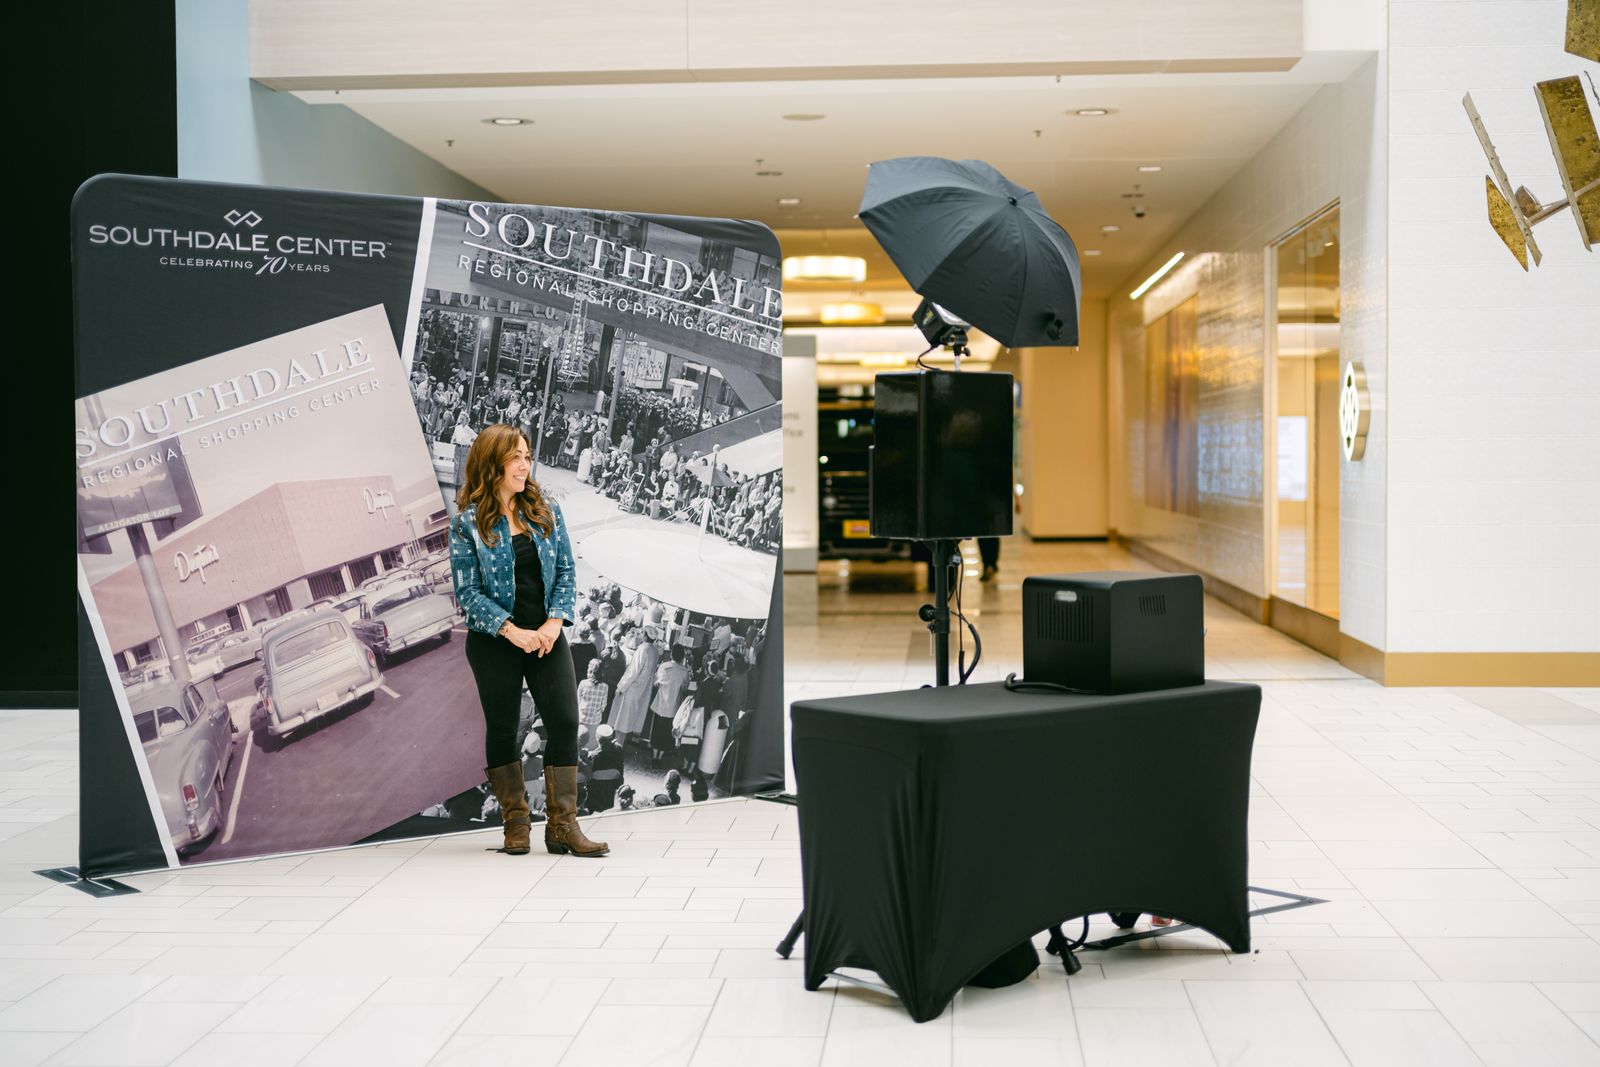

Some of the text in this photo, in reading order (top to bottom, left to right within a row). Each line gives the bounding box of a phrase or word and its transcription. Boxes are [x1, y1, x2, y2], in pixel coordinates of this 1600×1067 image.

[89, 225, 386, 258] SOUTHDALE CENTER
[159, 255, 330, 275] CELEBRATING 70 YEARS
[465, 203, 783, 321] SOUTHDALE
[459, 254, 780, 355] REGIONAL SHOPPING CENTER
[76, 337, 373, 459] SOUTHDALE
[82, 378, 382, 489] REGIONAL SHOPPING CENTER
[153, 507, 171, 519] LOT
